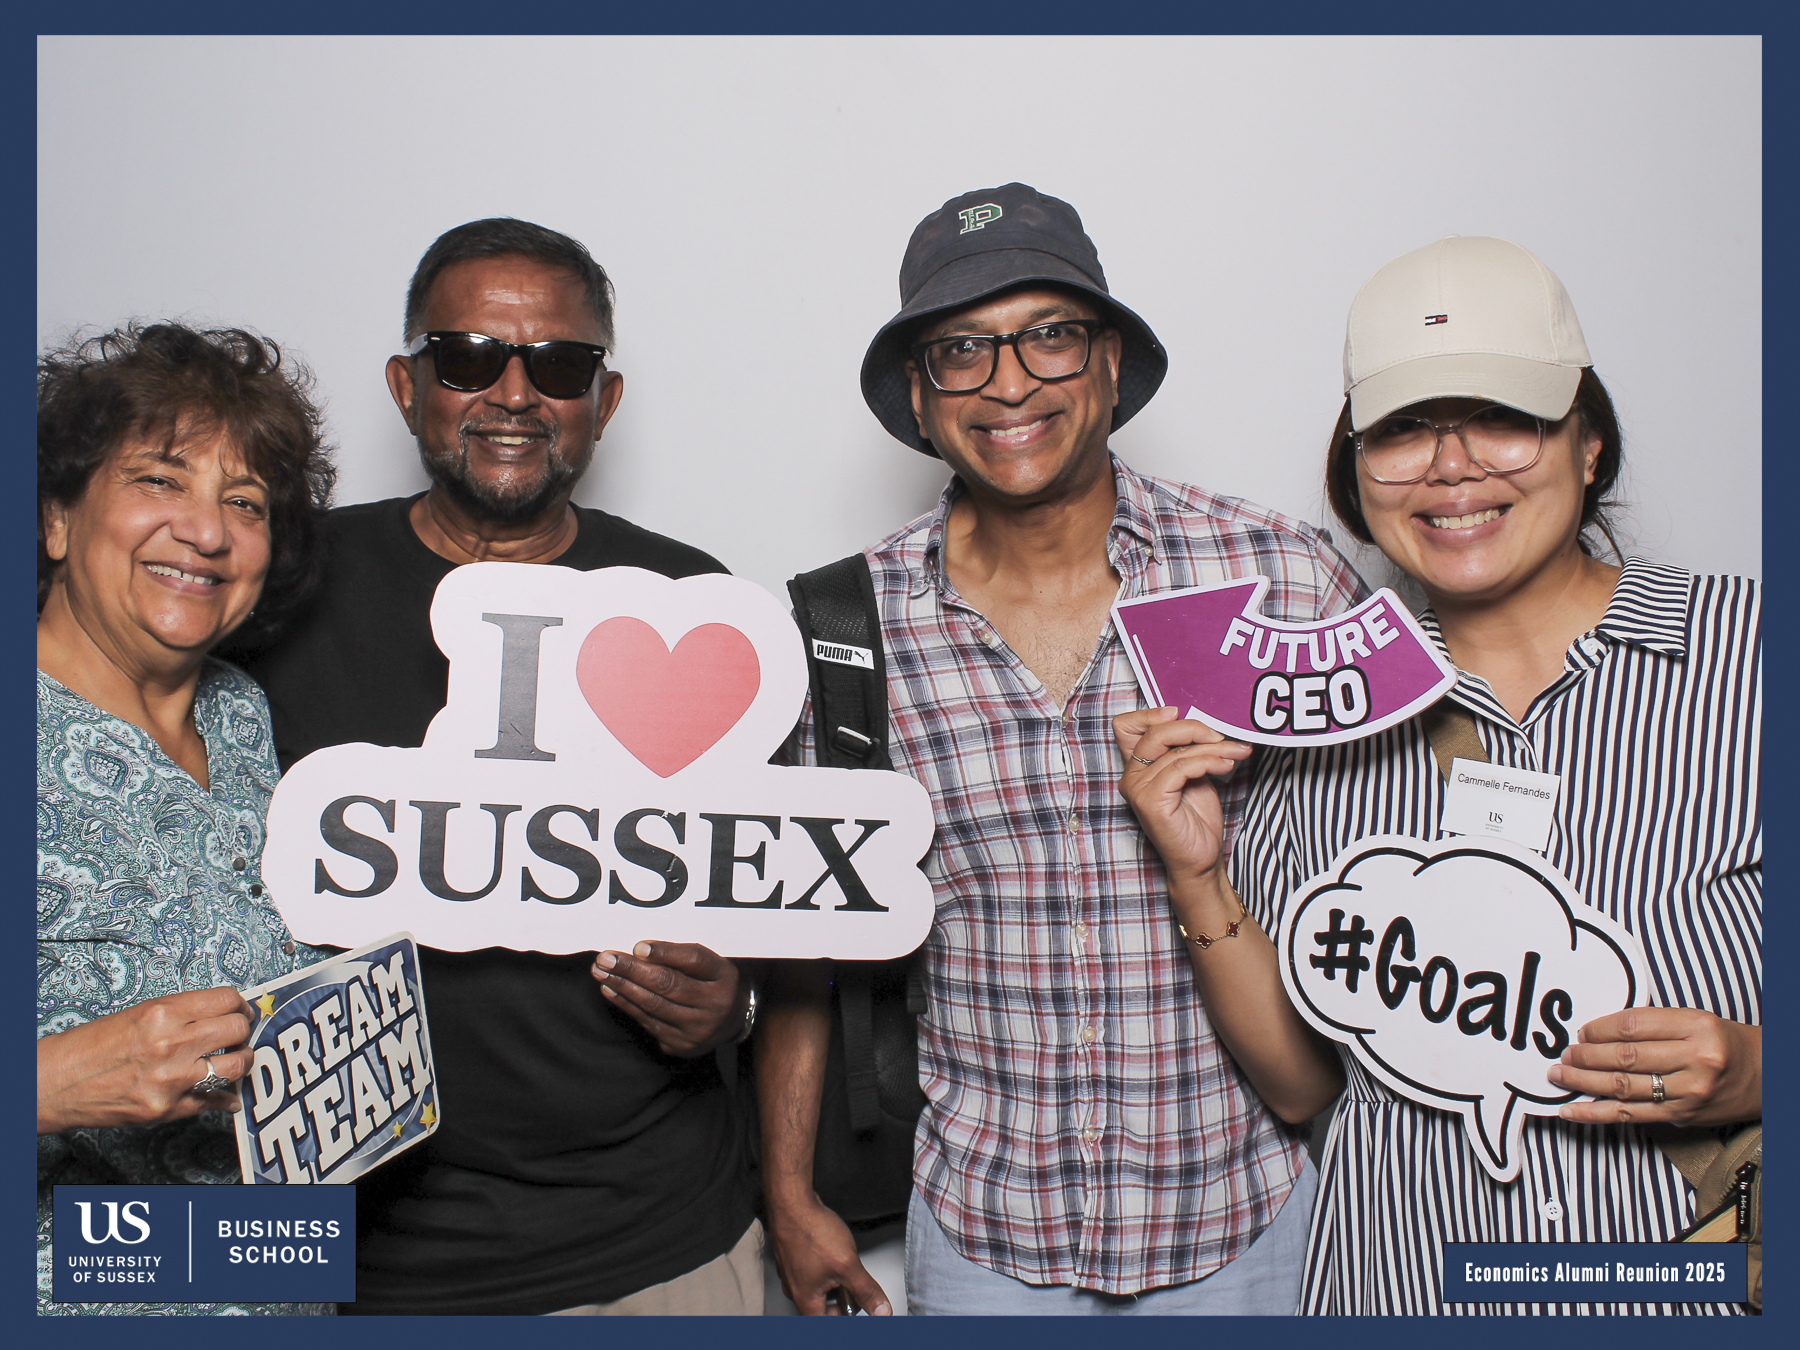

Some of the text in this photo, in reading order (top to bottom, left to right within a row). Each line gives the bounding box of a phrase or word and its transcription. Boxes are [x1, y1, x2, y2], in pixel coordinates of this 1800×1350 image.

[958, 203, 1003, 235] P
[816, 644, 853, 662] PUMA
[1219, 602, 1400, 673] FUTURE
[474, 612, 564, 762] I
[1252, 667, 1370, 732] CEO
[1457, 773, 1551, 800] Cammelle Fernandes
[314, 795, 890, 913] SUSSEX
[1309, 908, 1573, 1059] #Goals
[251, 950, 415, 1123] DREAM
[259, 1013, 432, 1185] TEAM
